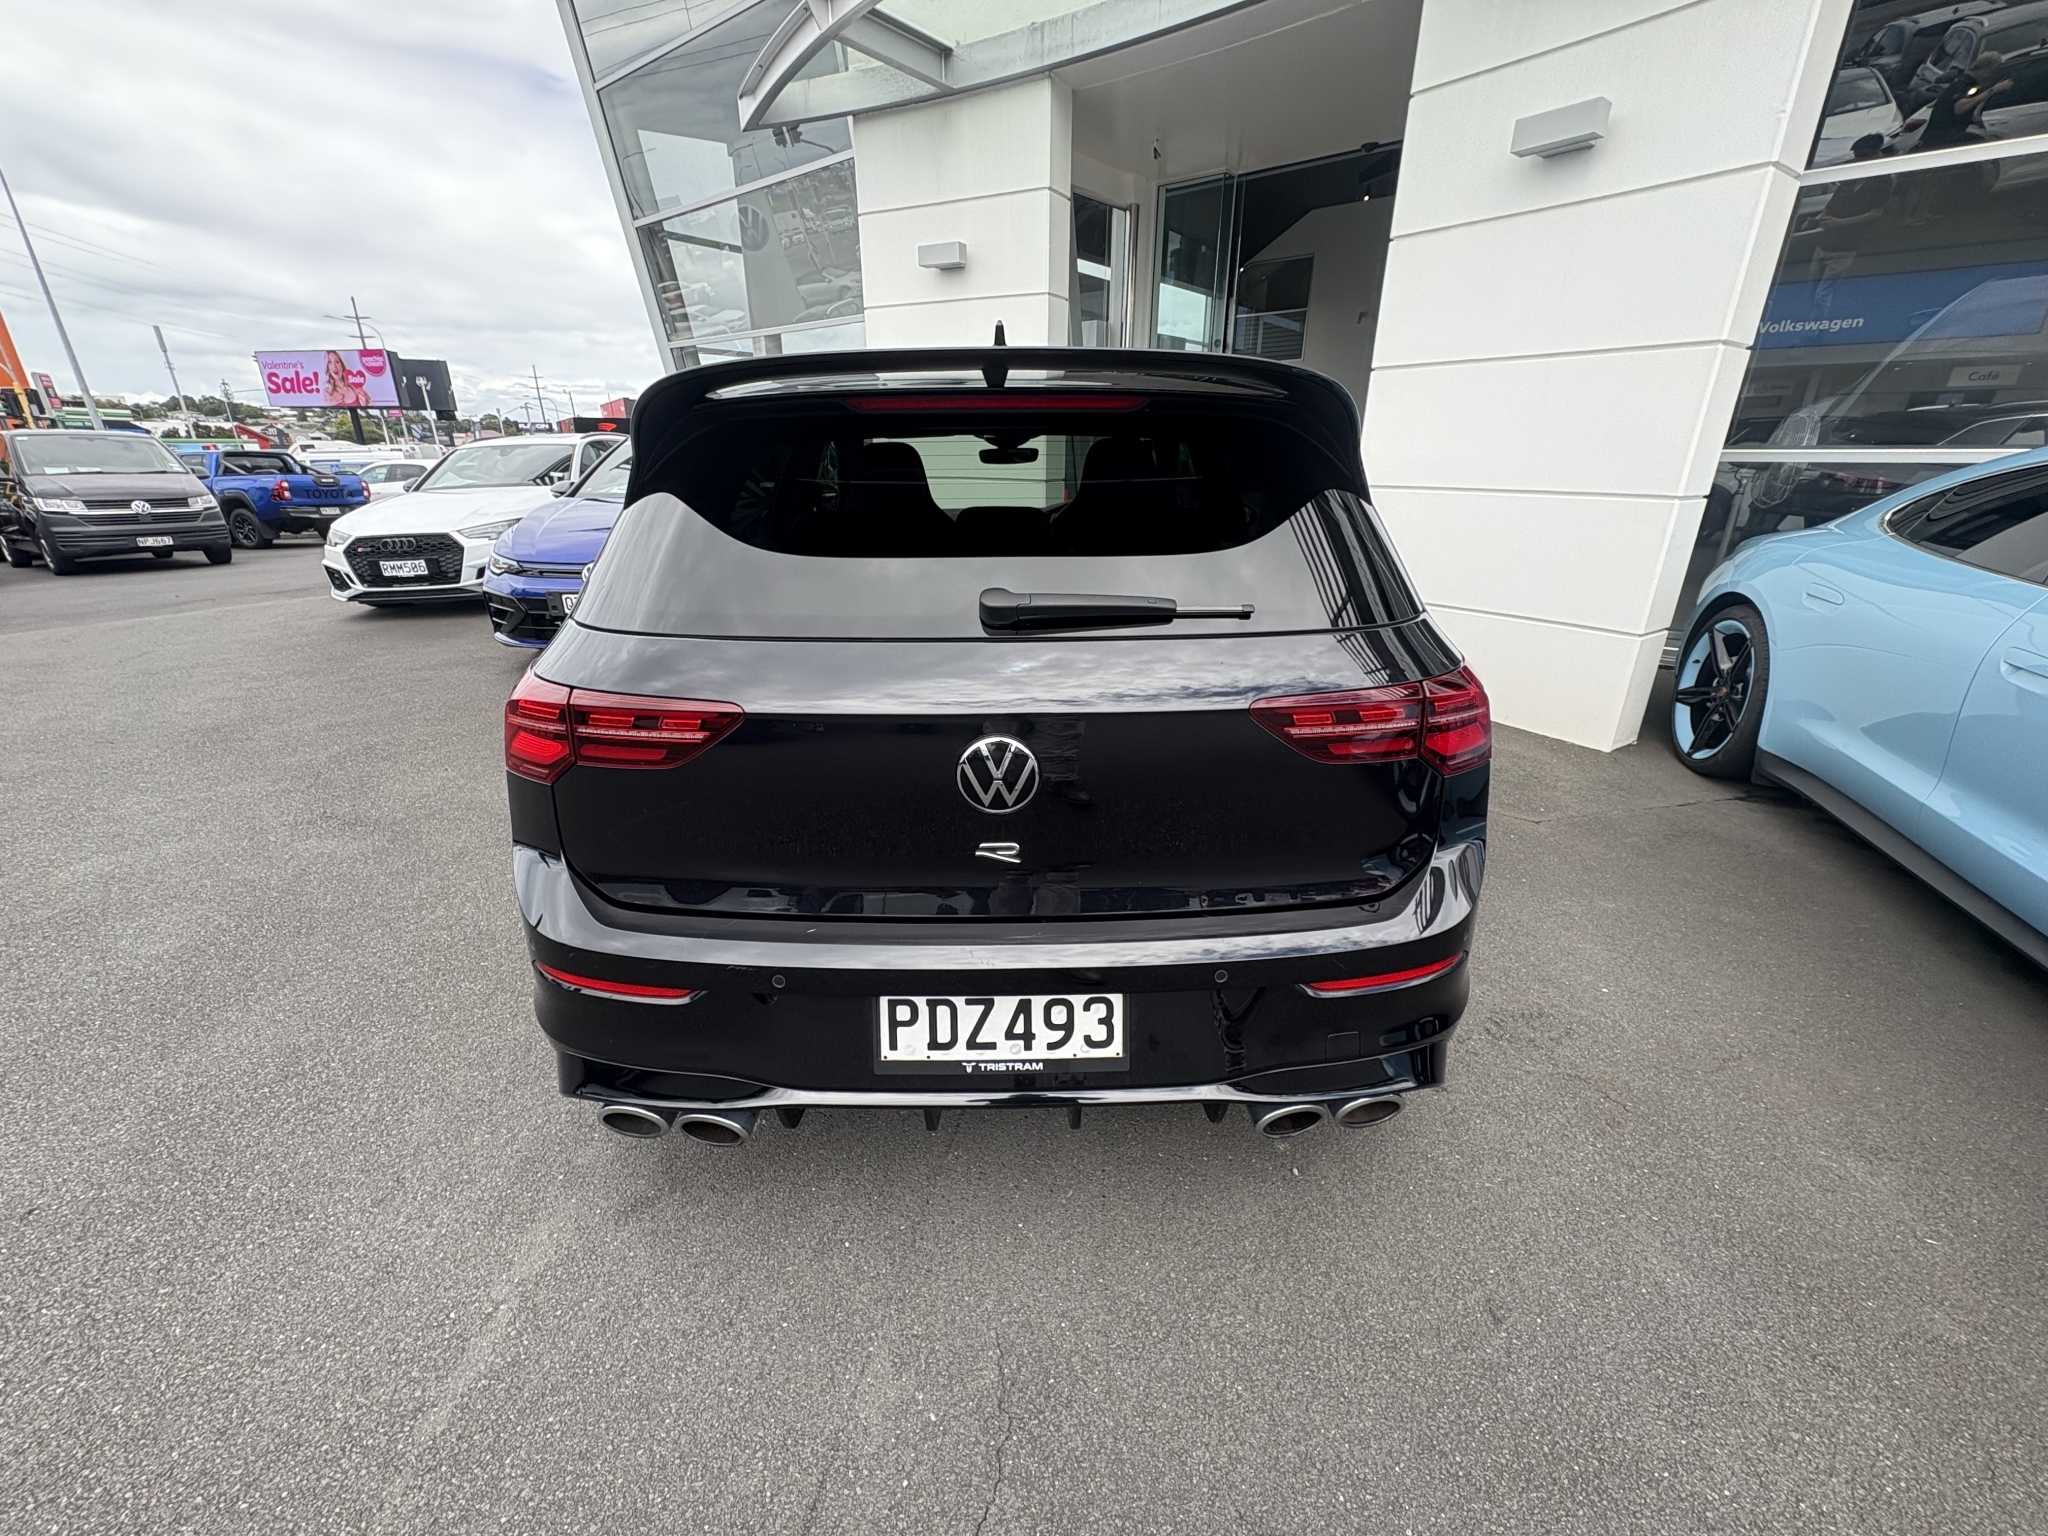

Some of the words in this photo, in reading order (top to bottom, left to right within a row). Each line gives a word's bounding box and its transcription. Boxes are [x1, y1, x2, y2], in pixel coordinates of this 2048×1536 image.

[1759, 317, 1865, 335] Volkswagen
[261, 360, 305, 370] Valentine's
[347, 374, 365, 384] Sale
[1968, 369, 2000, 382] Café
[266, 370, 321, 395] Sale!
[304, 489, 355, 499] TOYOTA
[381, 561, 427, 575] RMM506
[887, 996, 1115, 1052] PDZ493
[978, 1062, 1044, 1072] TRISTRAM
